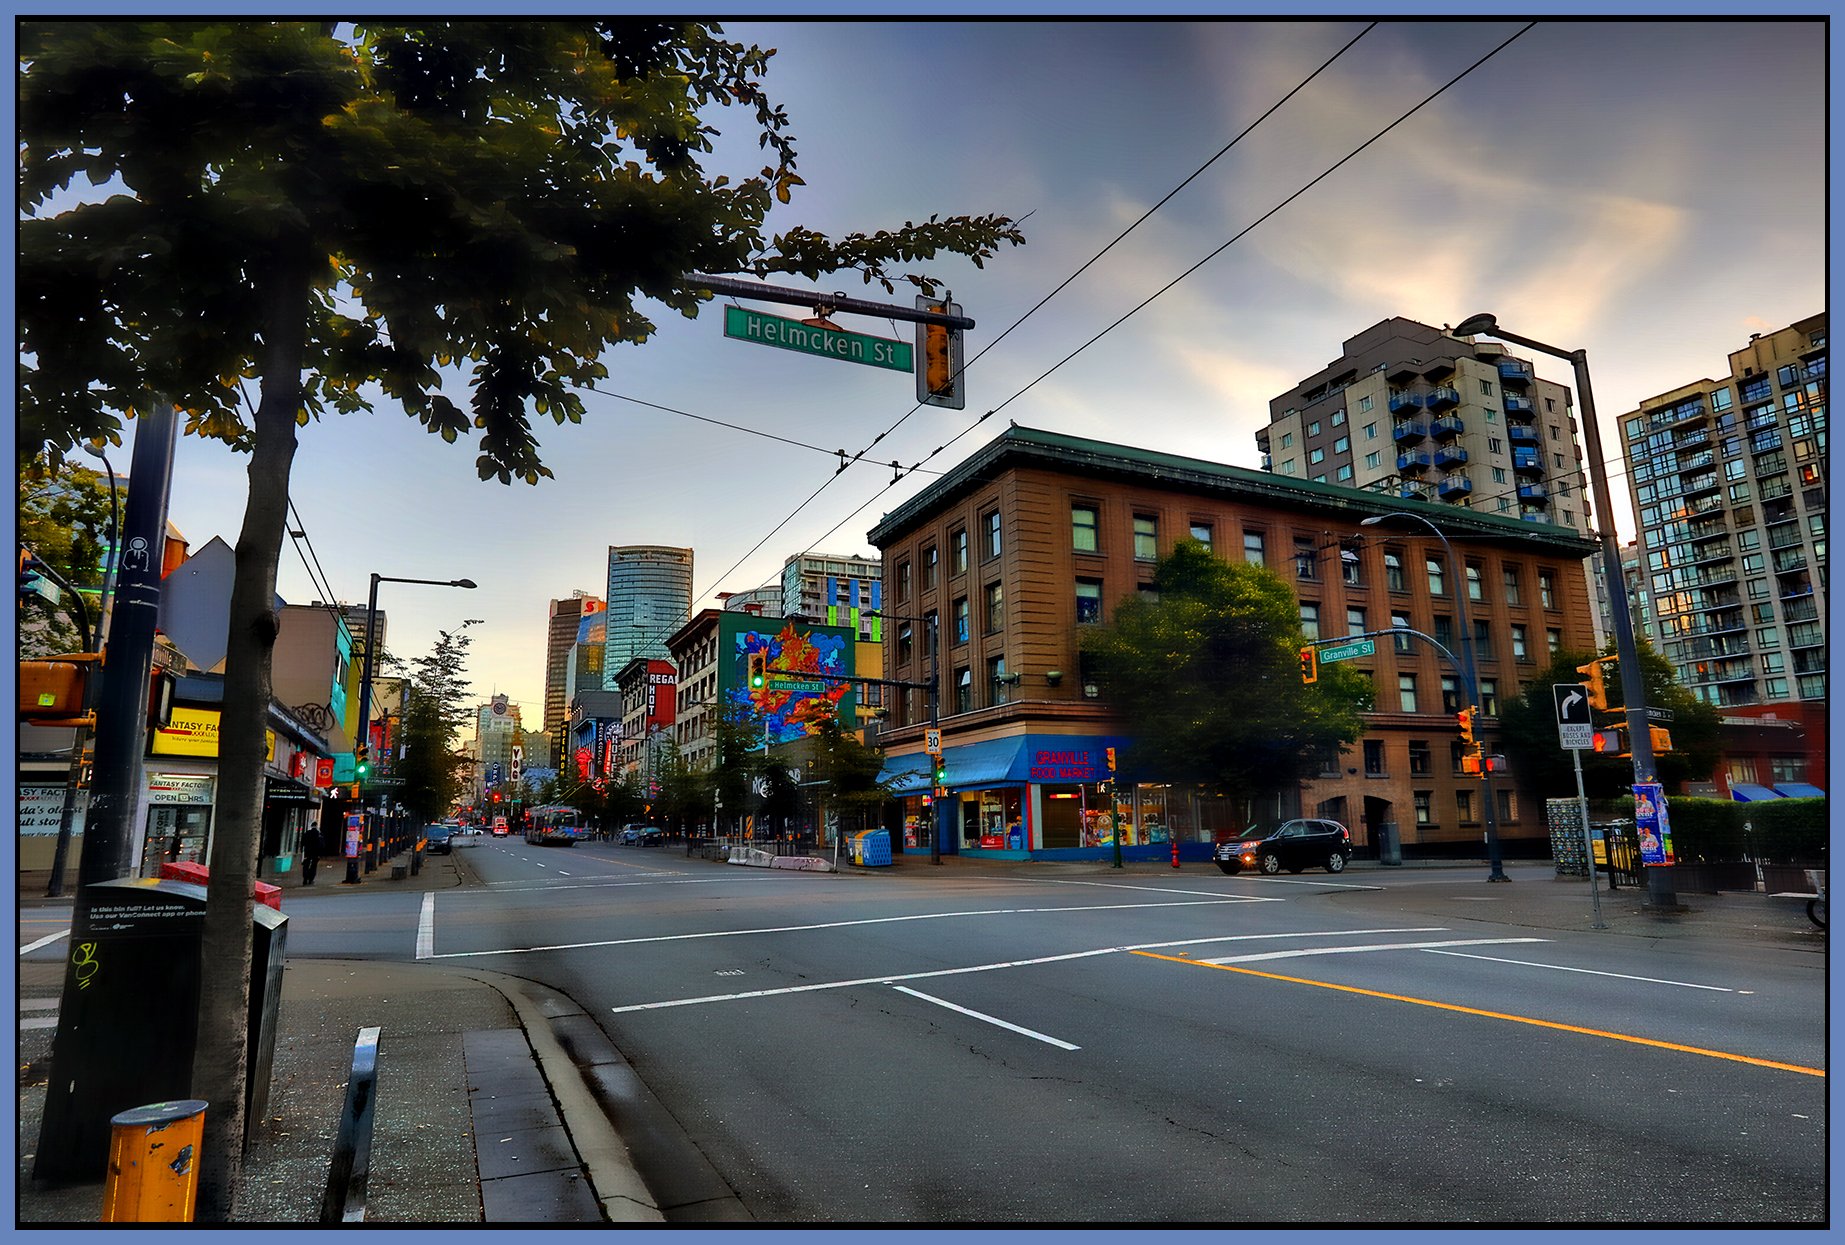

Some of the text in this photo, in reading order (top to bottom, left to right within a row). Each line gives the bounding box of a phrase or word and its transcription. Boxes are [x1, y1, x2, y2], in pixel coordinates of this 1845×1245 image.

[747, 316, 894, 364] Helmcken St
[1323, 643, 1372, 661] Granville St
[774, 681, 819, 691] Helmcken St
[171, 721, 203, 731] NTASY
[928, 737, 939, 748] 30
[1036, 751, 1089, 765] GRANVILLE
[1031, 767, 1095, 779] FOOD MARKET
[149, 780, 180, 788] FANTASY
[38, 818, 62, 826] stor
